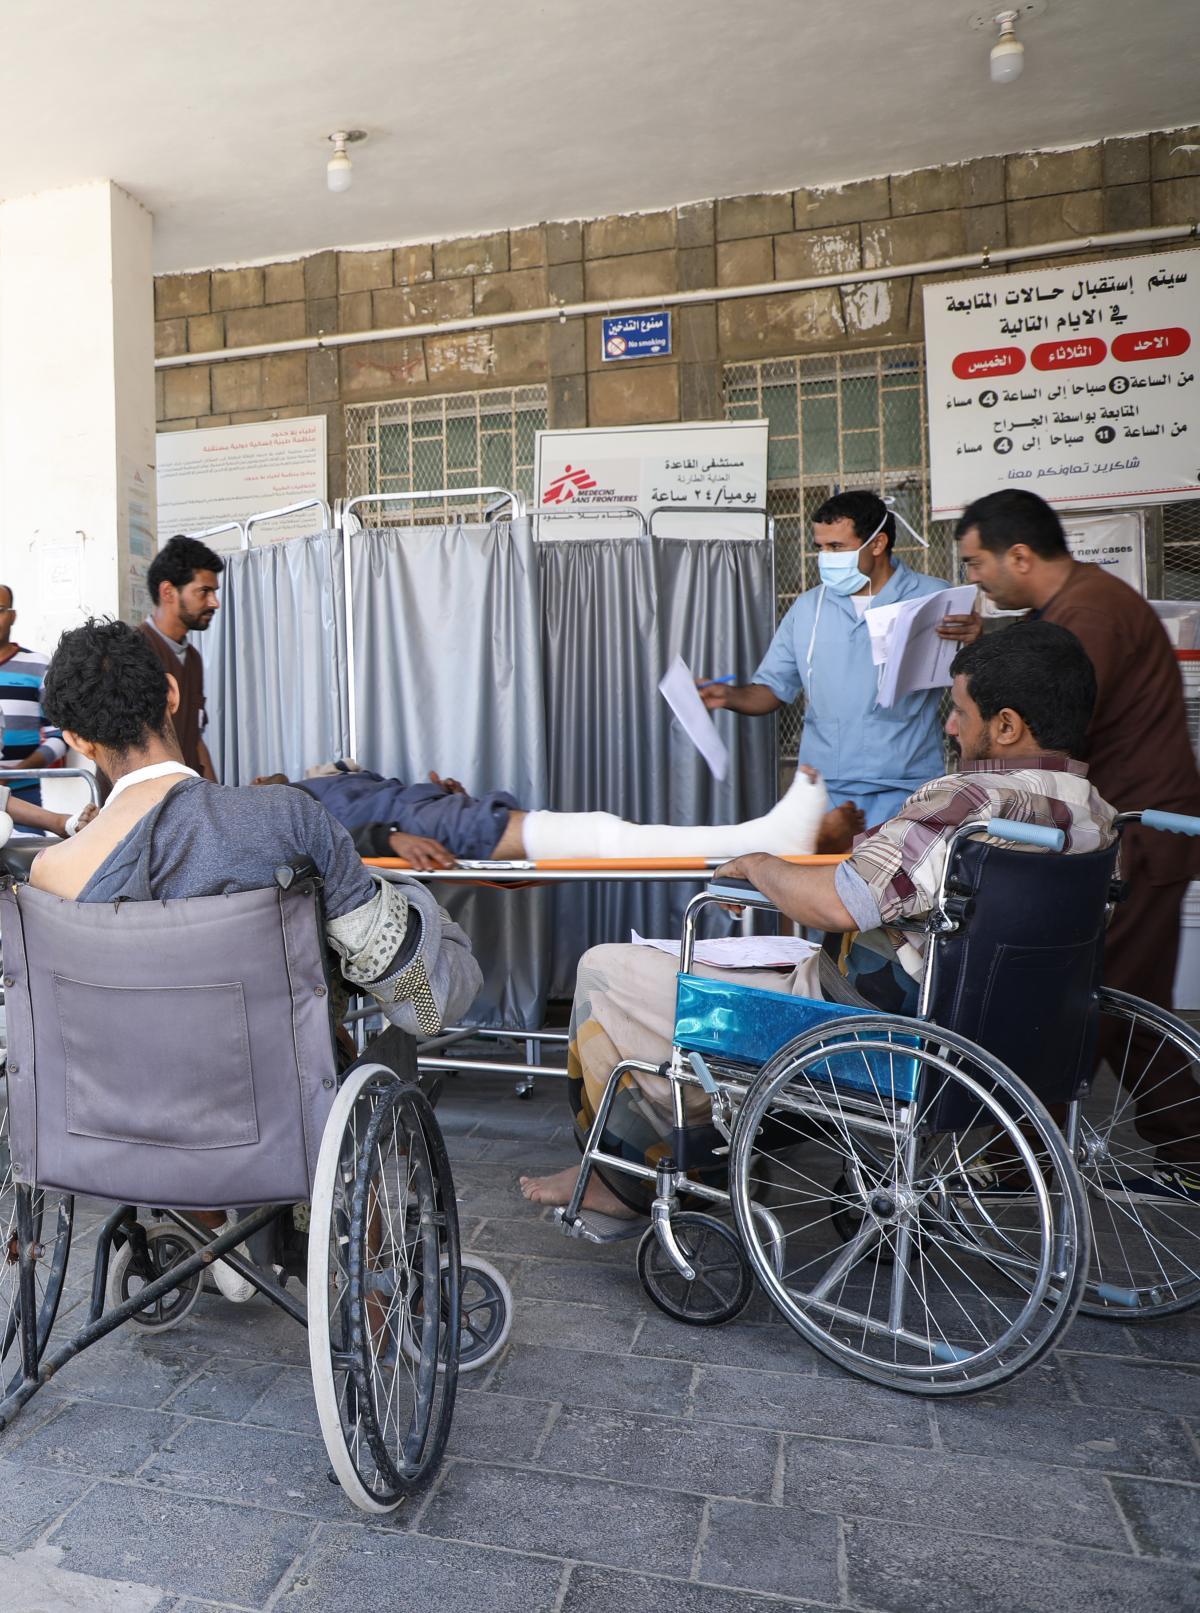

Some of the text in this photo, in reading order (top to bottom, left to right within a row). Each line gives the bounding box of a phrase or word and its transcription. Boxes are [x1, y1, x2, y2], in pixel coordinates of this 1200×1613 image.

[1148, 269, 1187, 291] سيتم
[1071, 275, 1134, 301] إستقبال
[947, 293, 997, 315] المتابعة
[608, 317, 663, 336] ممنوع التدخين
[1000, 304, 1128, 338] في الايام التالية
[638, 338, 666, 347] smoking
[968, 336, 1169, 373] الاحد الثلاثاء الخميس
[1130, 374, 1171, 388] الساعة
[1177, 371, 1195, 387] من
[1003, 389, 1042, 402] الساعة
[1047, 386, 1067, 401] إلى
[1053, 410, 1096, 424] بواسطة
[1100, 404, 1139, 421] المتابعة
[1123, 424, 1165, 438] الساعة
[1170, 422, 1188, 437] من
[1022, 437, 1041, 452] إلى
[665, 458, 744, 472] مستشفى القاعدة
[1007, 457, 1141, 480] شاكرين تعاونكم معنا
[578, 488, 615, 496] MEDECINS
[591, 495, 638, 503] FRONTIERES
[651, 487, 687, 502] ساعة
[1077, 548, 1100, 556] new
[1102, 545, 1133, 554] cases
